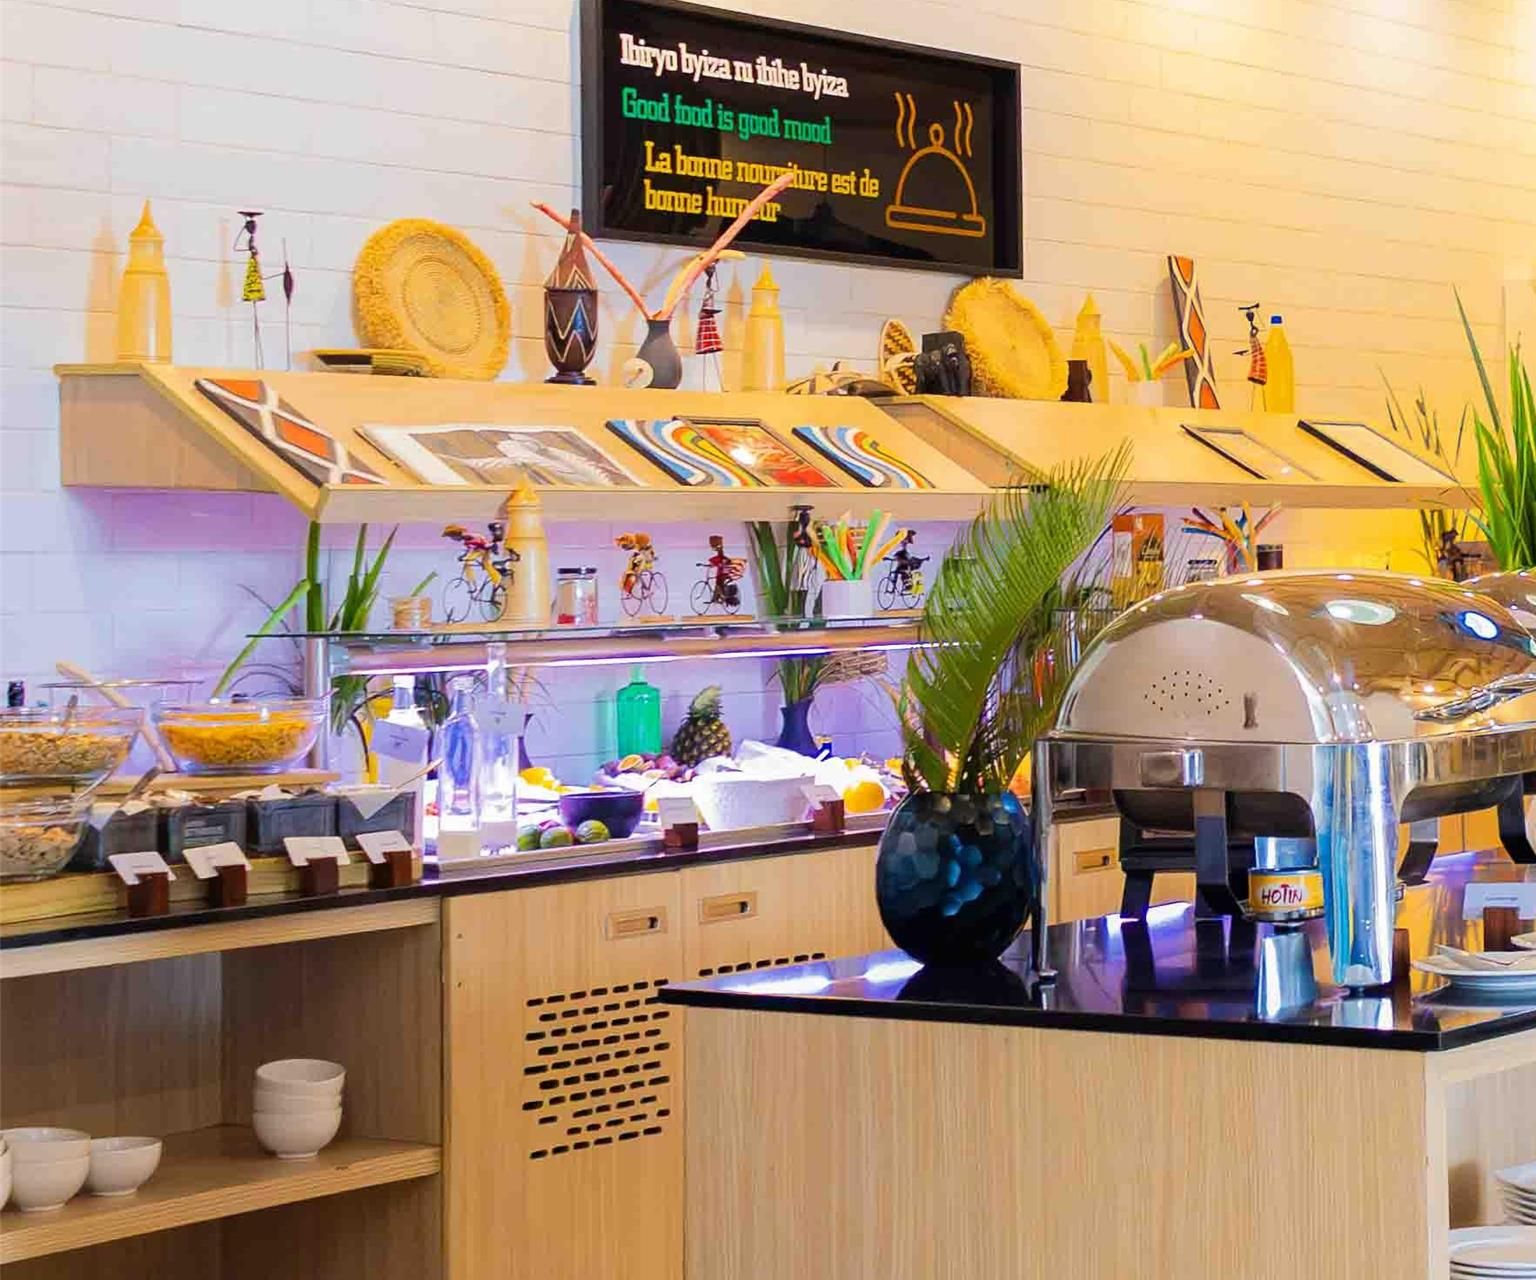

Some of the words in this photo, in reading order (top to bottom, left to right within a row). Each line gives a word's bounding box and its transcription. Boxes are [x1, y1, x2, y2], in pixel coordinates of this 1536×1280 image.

[619, 33, 678, 77] Ibiryo
[678, 42, 732, 82] byiza
[755, 56, 800, 90] ibihe
[800, 62, 850, 100] byiza
[622, 87, 671, 123] Good
[674, 94, 713, 129] food
[717, 103, 735, 131] is
[738, 108, 780, 140] good
[783, 116, 832, 144] mood
[643, 179, 702, 214] bonne
[644, 141, 672, 174] La
[674, 144, 733, 181] bonne
[831, 171, 856, 195] est
[859, 168, 880, 198] de
[1261, 883, 1303, 905] HOTIN
